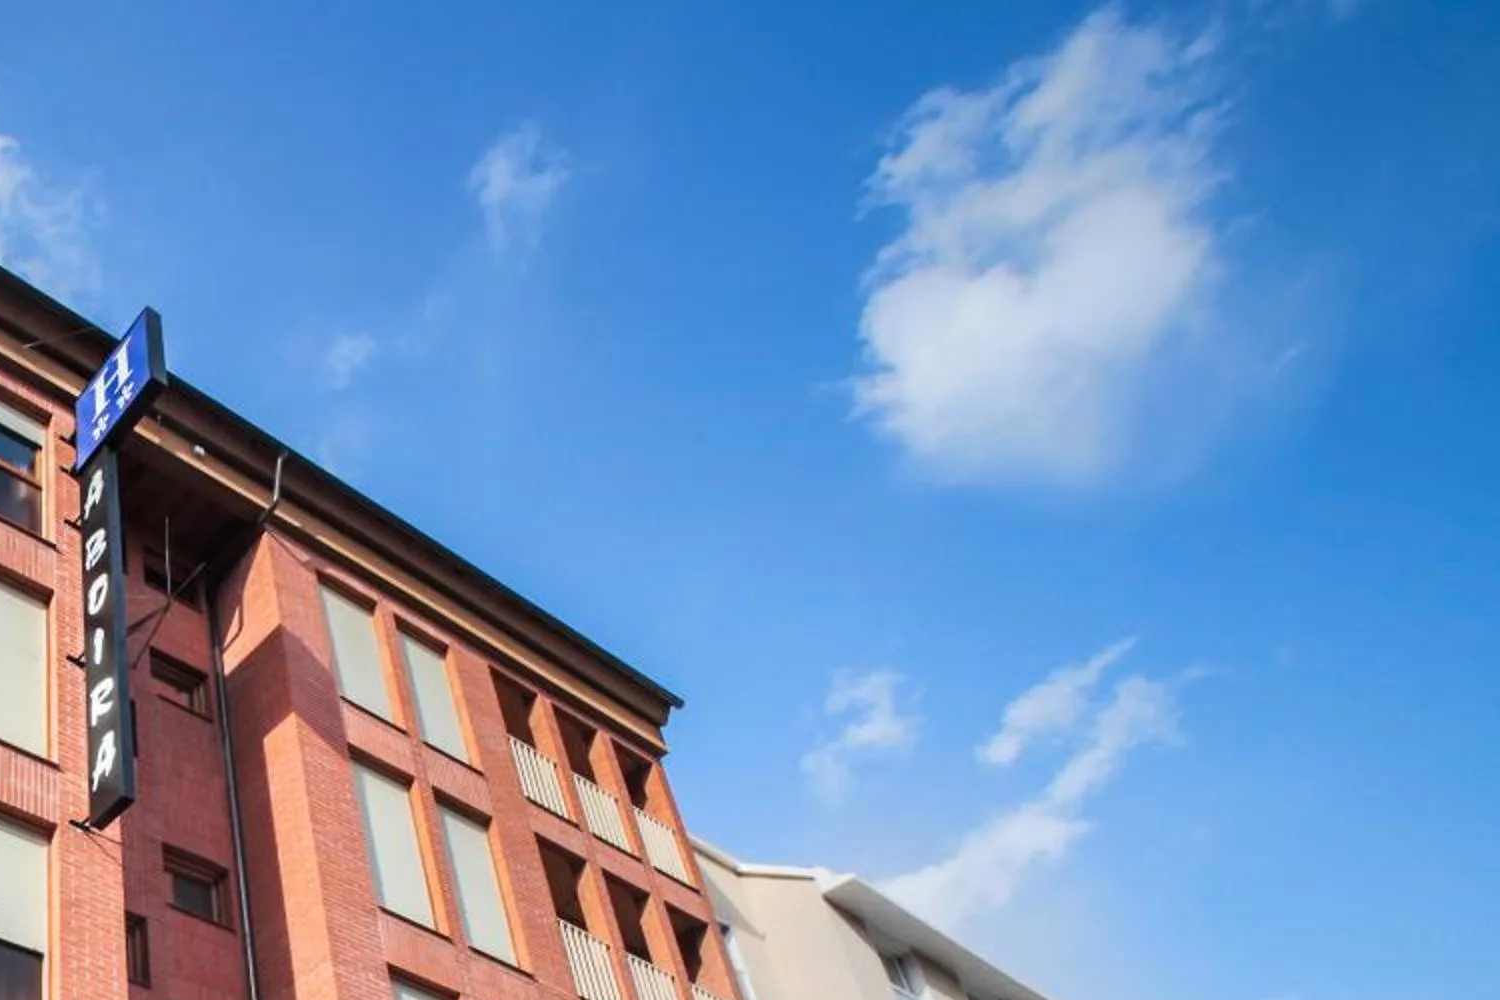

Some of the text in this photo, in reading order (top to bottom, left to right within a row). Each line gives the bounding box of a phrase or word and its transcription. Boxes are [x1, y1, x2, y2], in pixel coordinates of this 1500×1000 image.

[86, 336, 133, 423] H
[84, 469, 116, 792] A BOIRA
